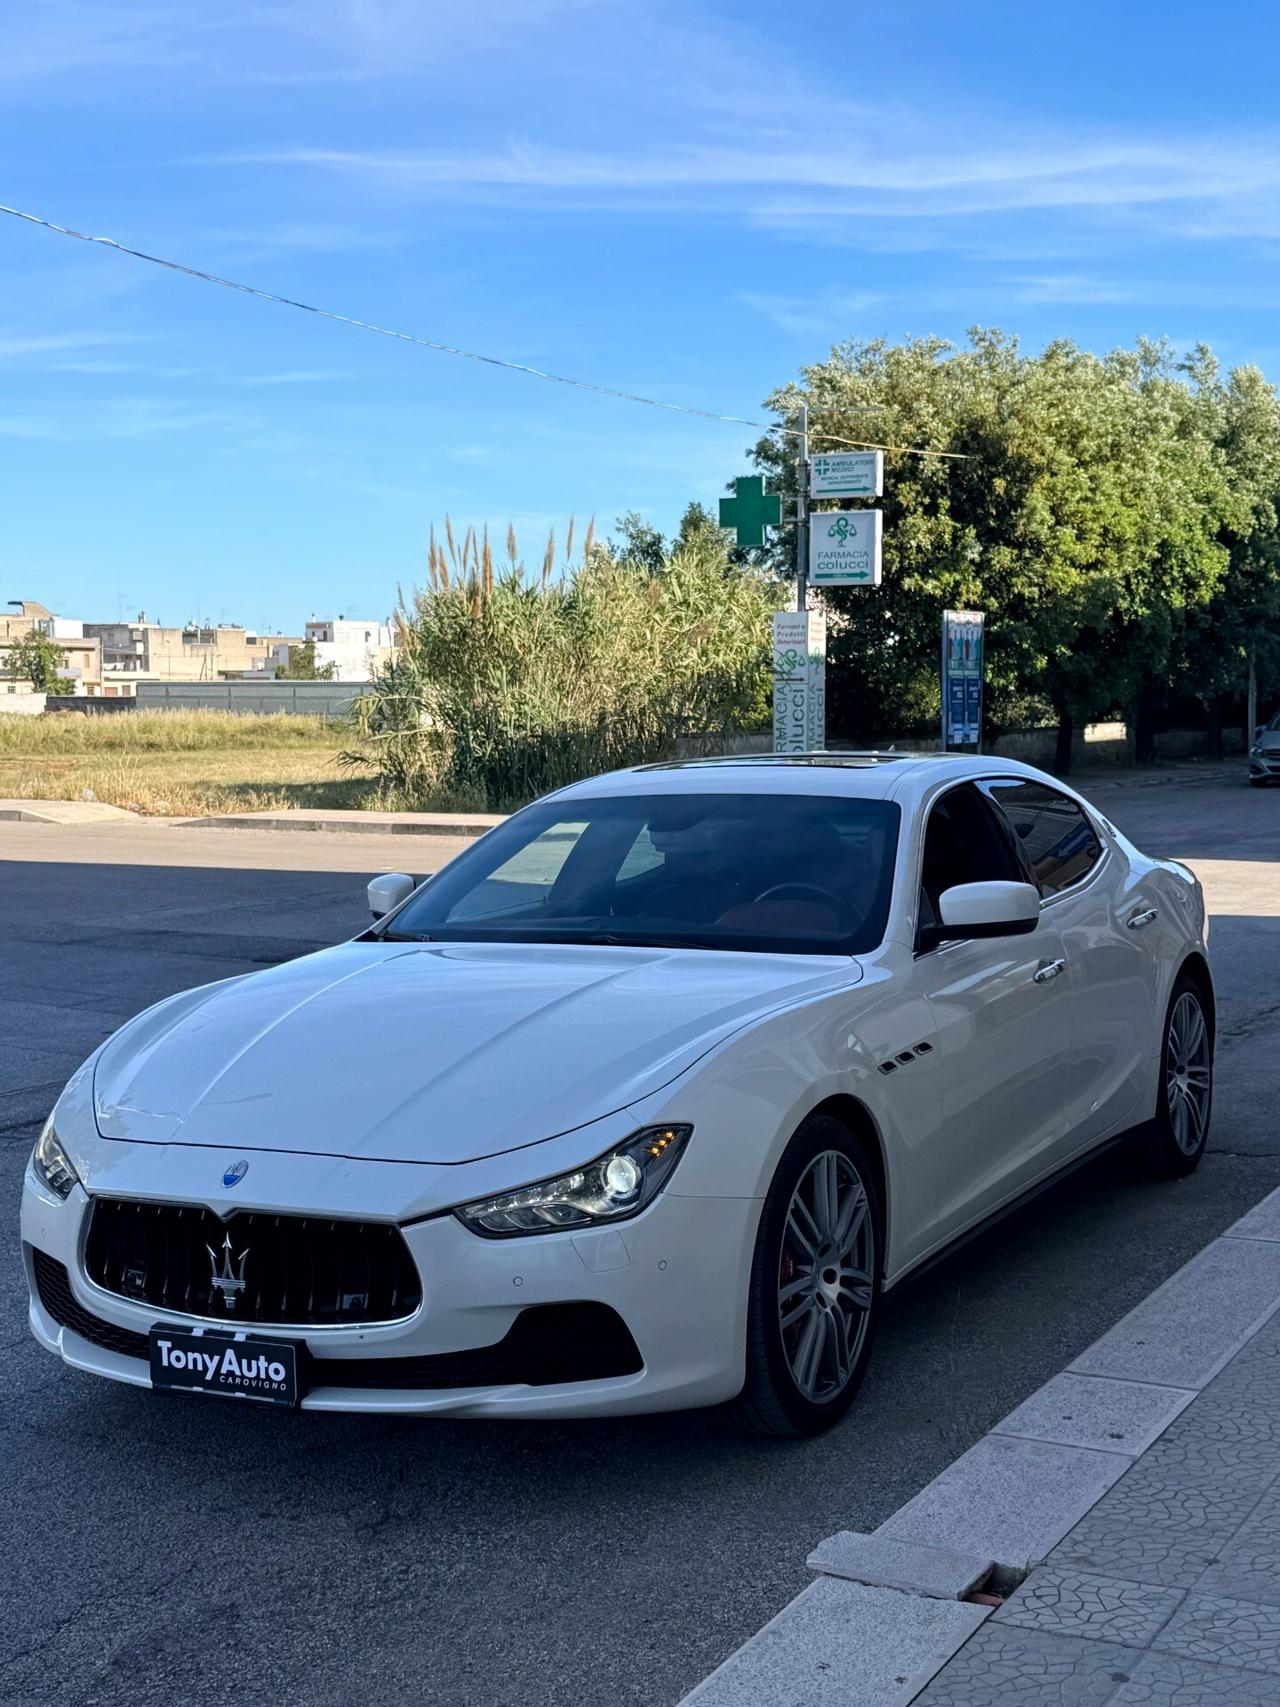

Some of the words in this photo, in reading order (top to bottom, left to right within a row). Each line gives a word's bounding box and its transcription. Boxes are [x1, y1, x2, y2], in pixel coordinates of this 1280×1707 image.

[817, 550, 870, 560] FARMACIA
[776, 686, 787, 752] RMACIA
[157, 1340, 286, 1381] TonyAuto
[219, 1375, 287, 1391] CAROVIGNO
